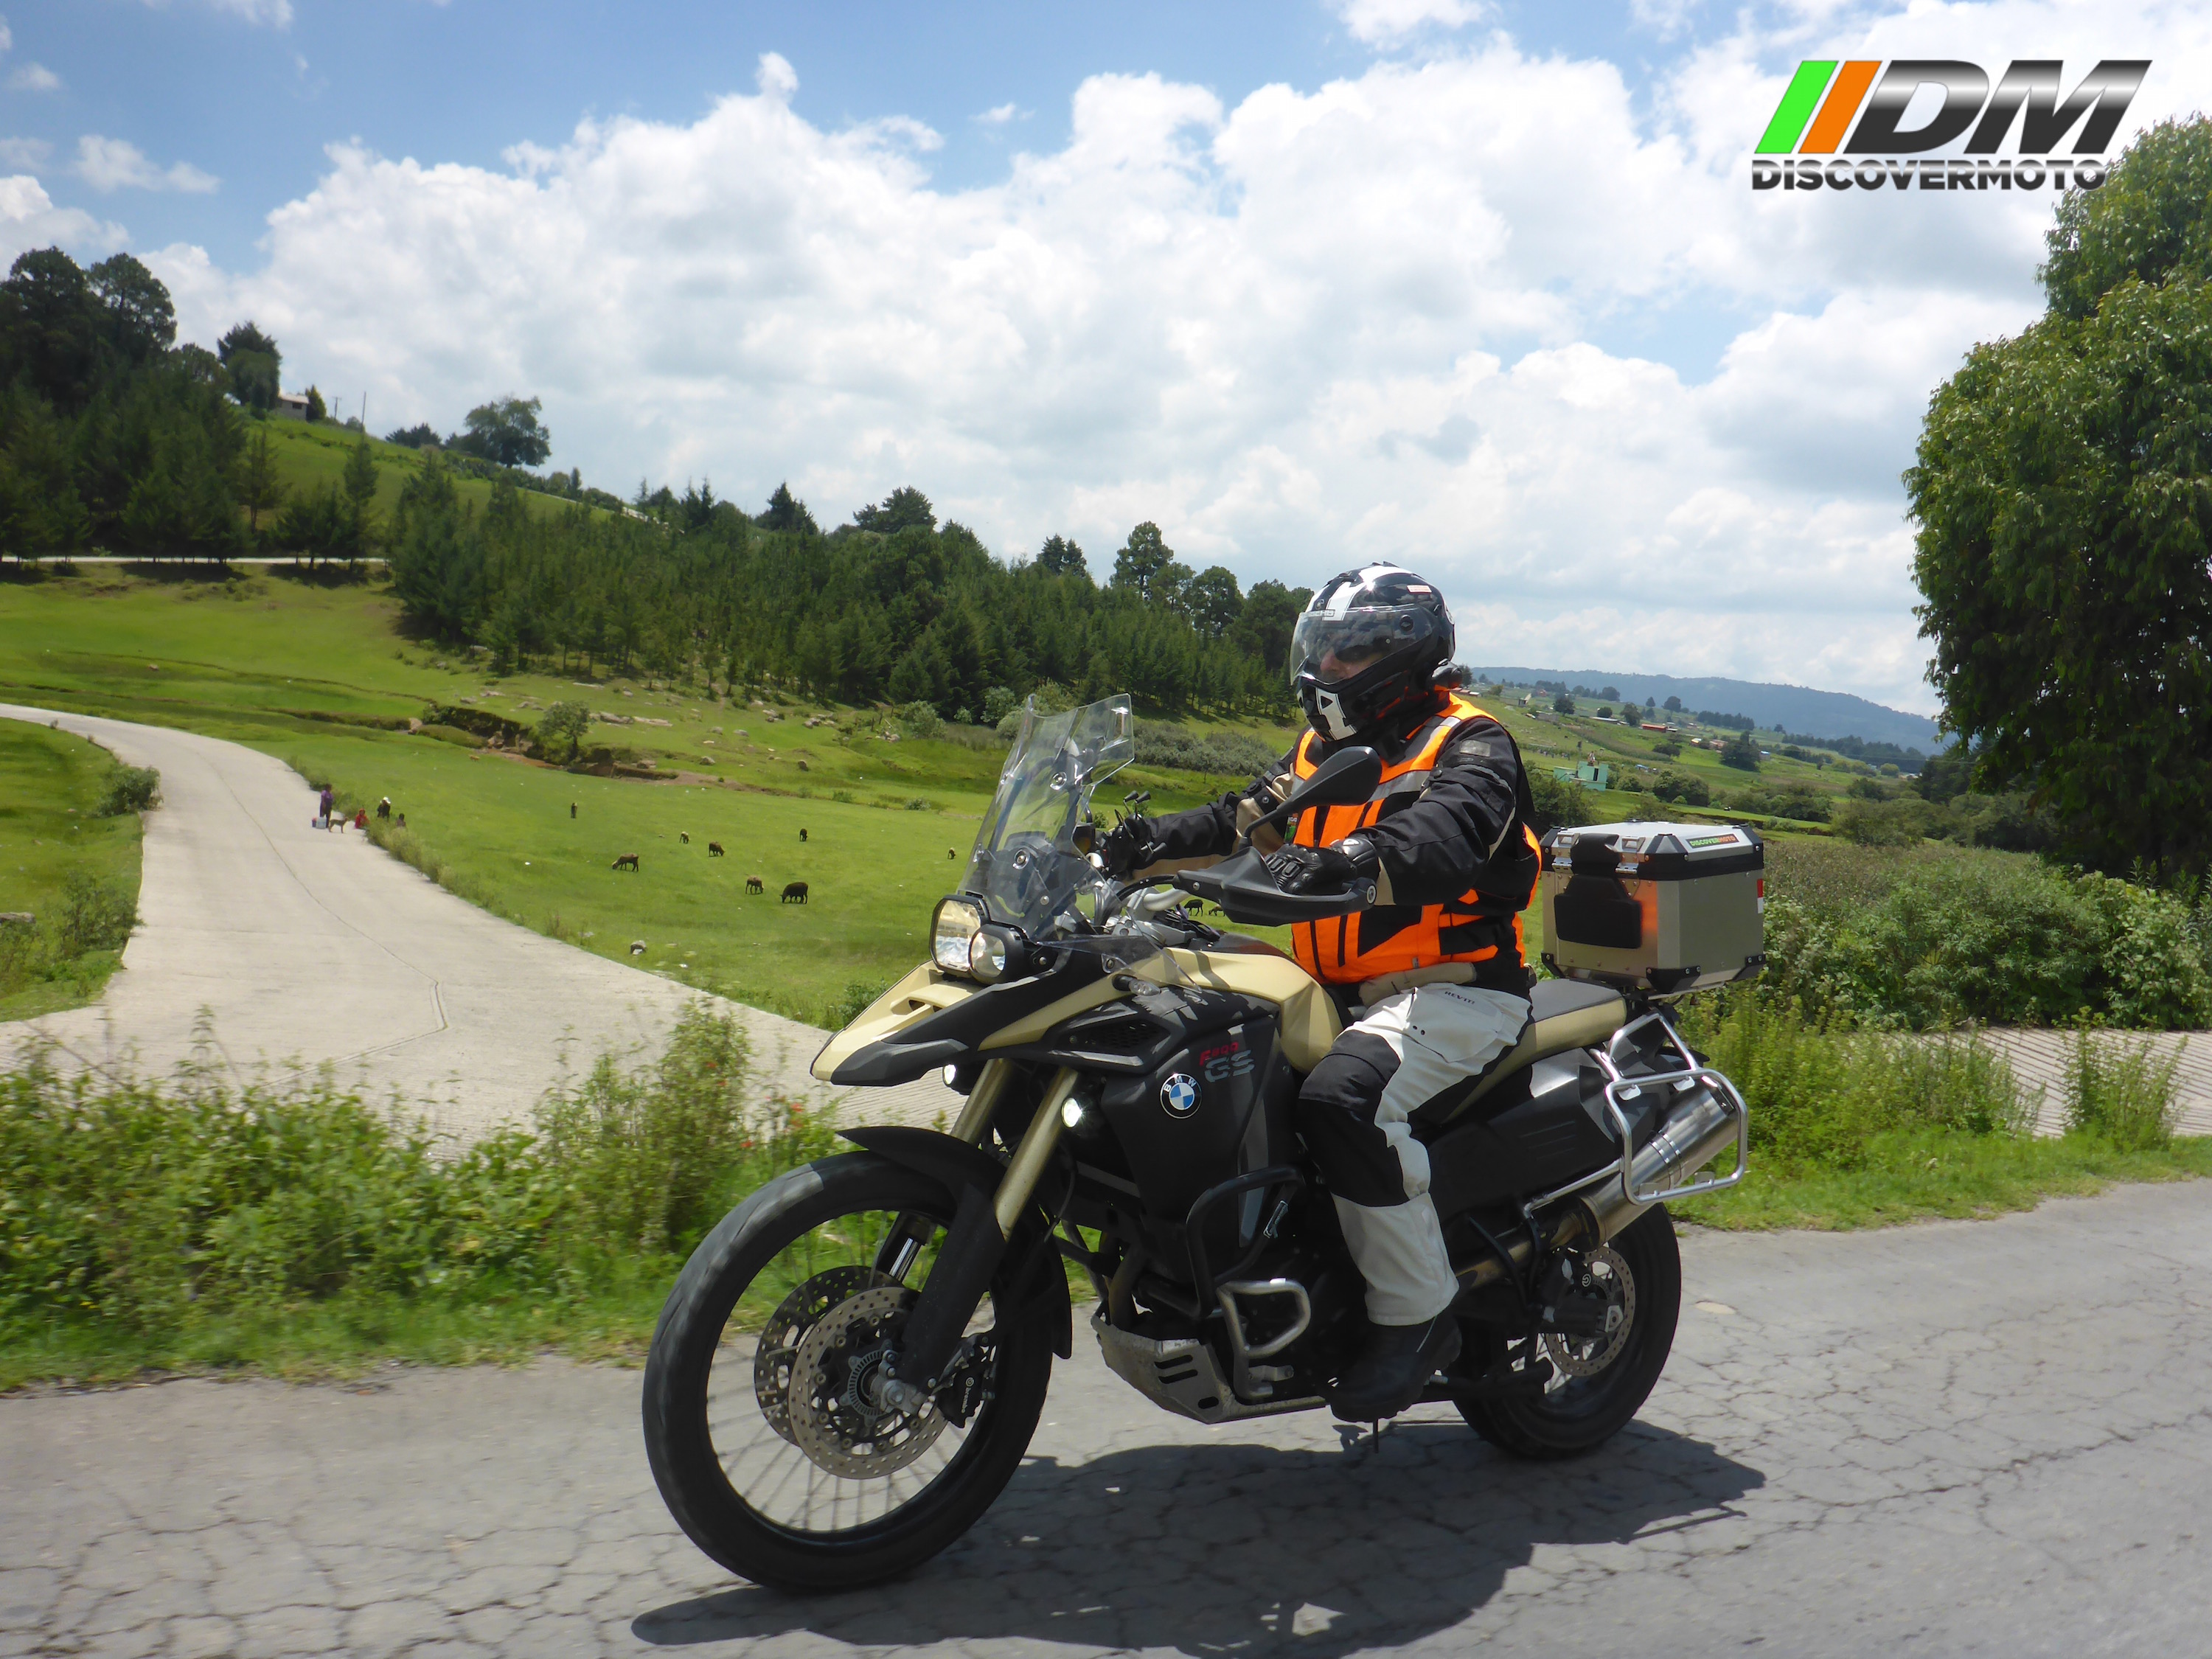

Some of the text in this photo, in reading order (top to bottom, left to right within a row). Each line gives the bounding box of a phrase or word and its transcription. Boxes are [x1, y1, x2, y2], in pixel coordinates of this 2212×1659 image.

[1689, 835, 1736, 846] DISCOVERMOTO
[1204, 1049, 1255, 1083] GS
[1164, 1075, 1196, 1092] BMW
